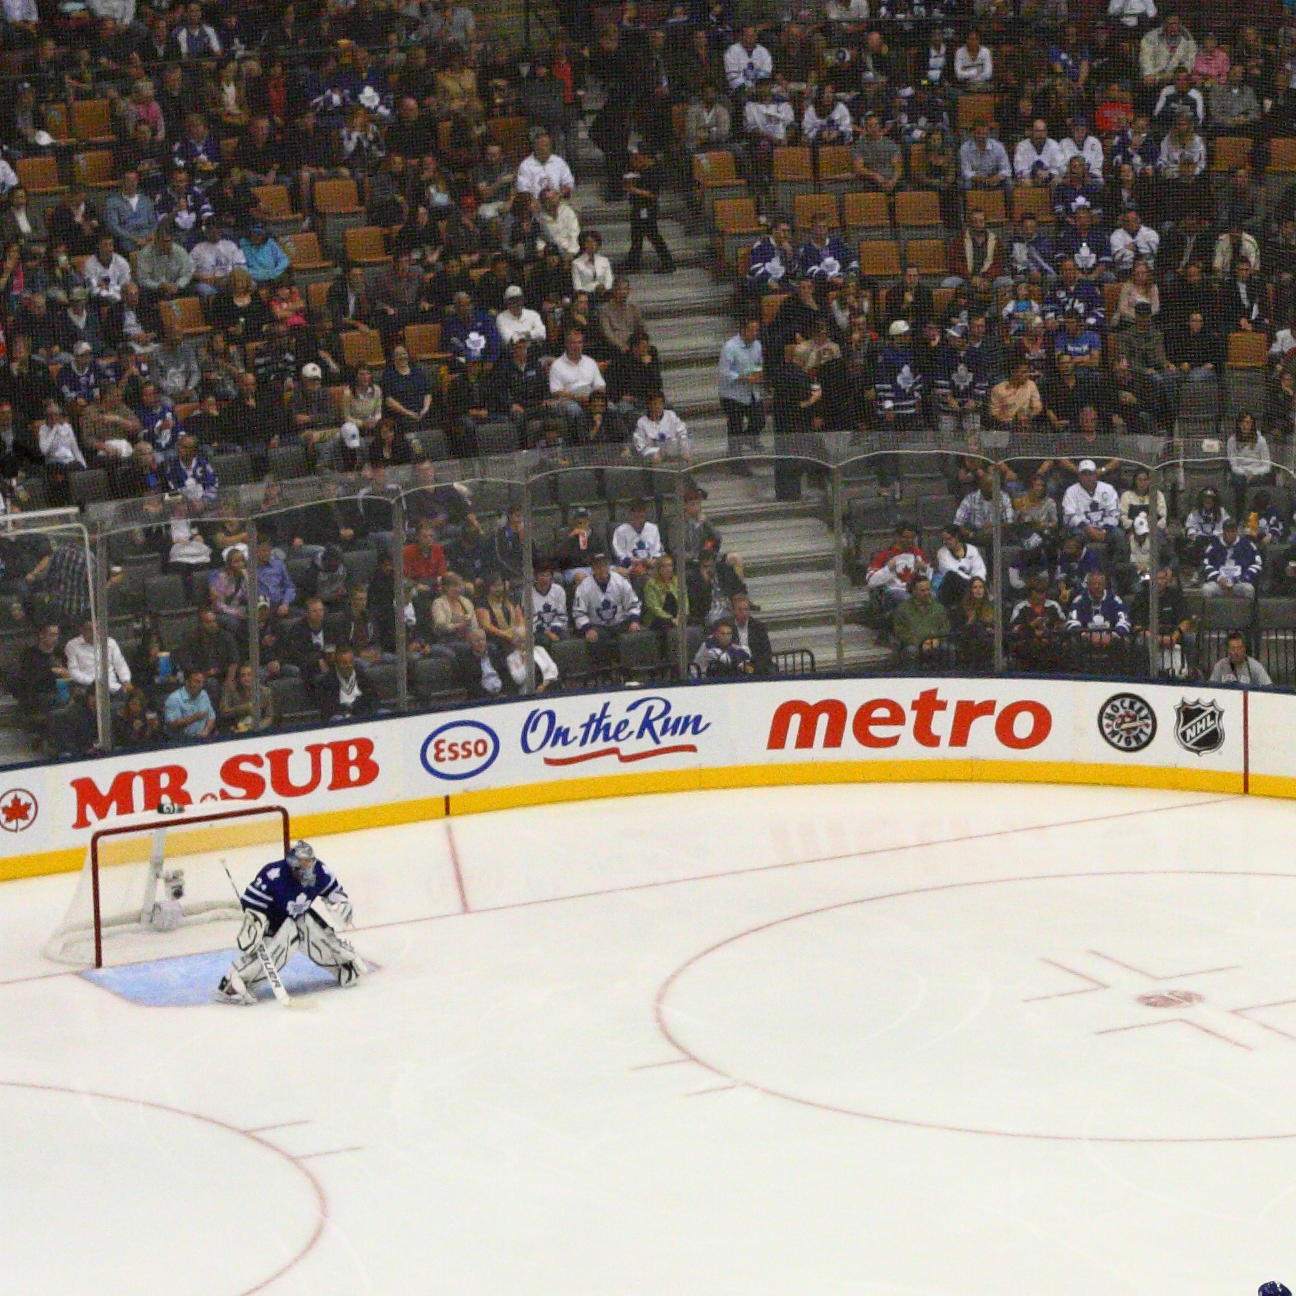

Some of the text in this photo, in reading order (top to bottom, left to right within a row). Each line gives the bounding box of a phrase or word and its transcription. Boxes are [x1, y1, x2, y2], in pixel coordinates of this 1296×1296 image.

[767, 687, 1053, 751] metro
[1104, 699, 1150, 724] HOCKEY
[520, 696, 712, 755] On the Run
[1107, 727, 1150, 748] NIGHT
[1184, 714, 1216, 744] NHL
[433, 740, 488, 763] Esso
